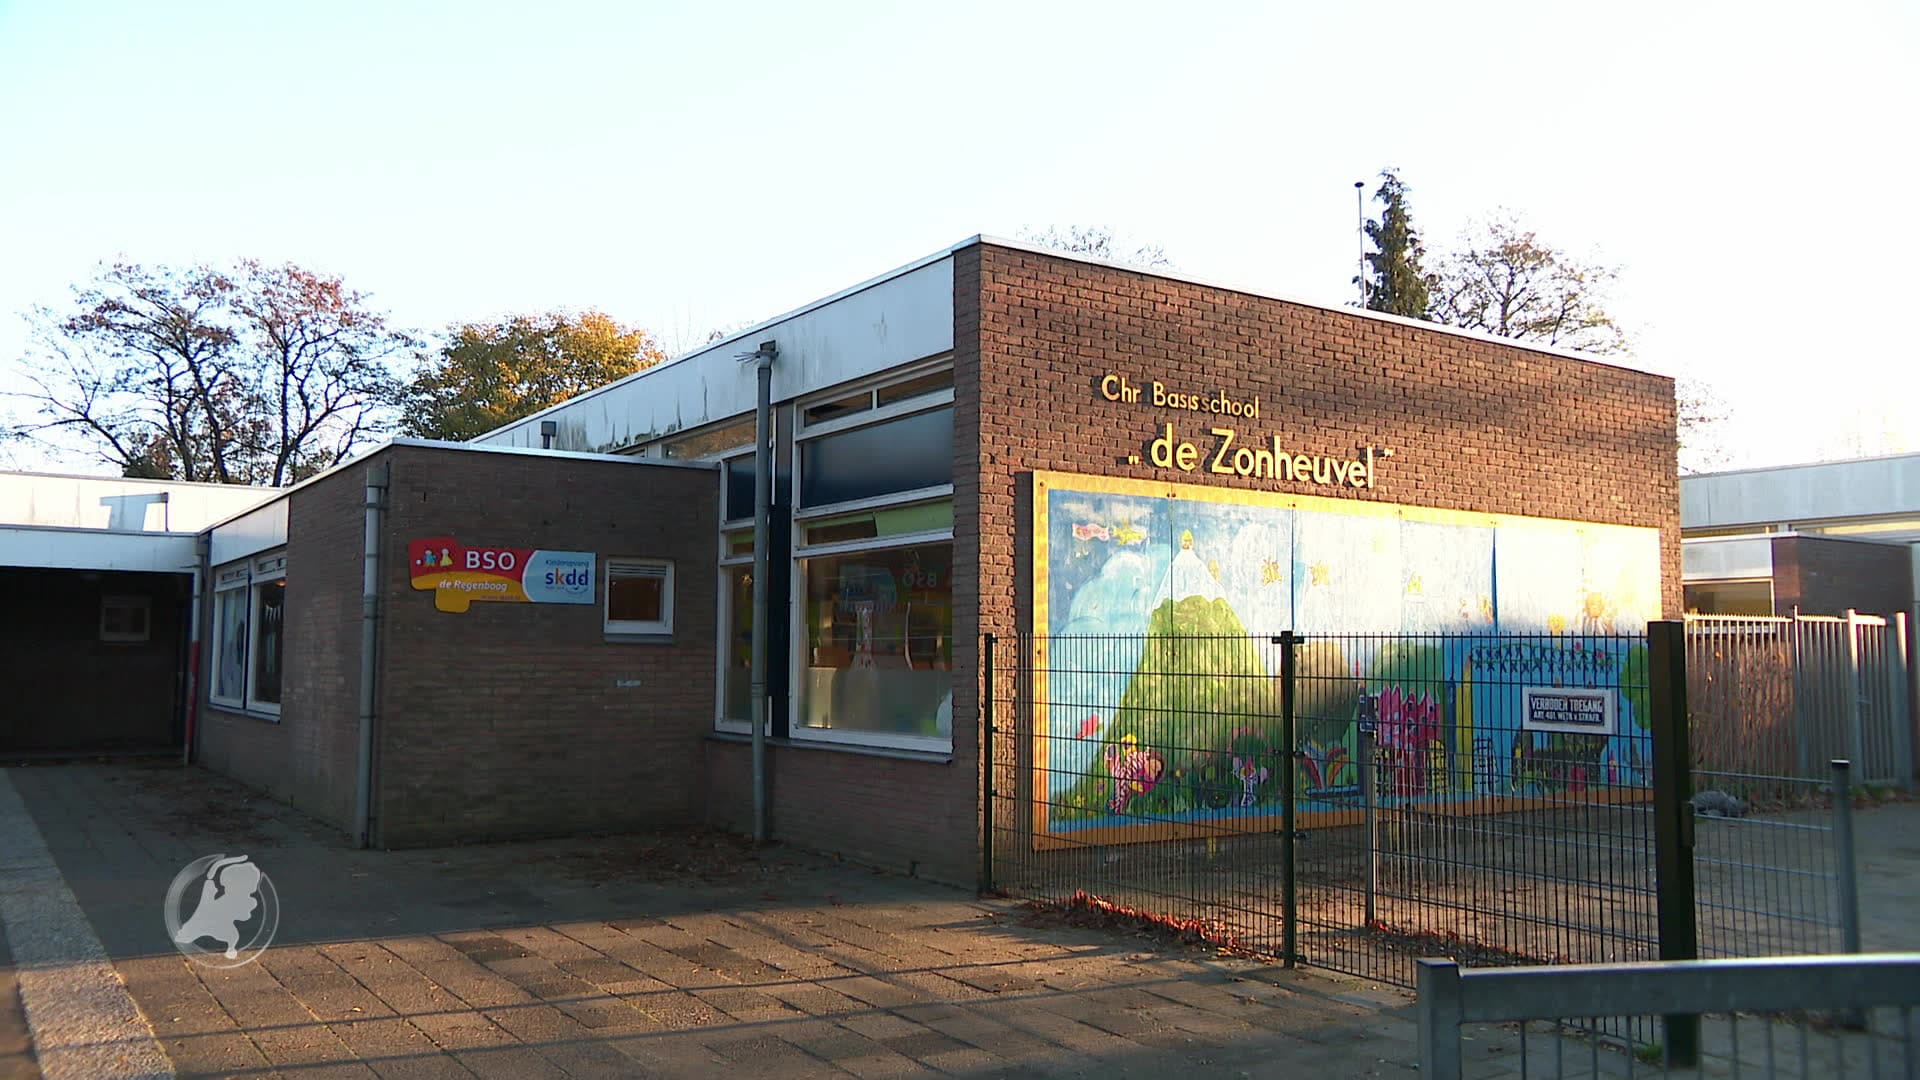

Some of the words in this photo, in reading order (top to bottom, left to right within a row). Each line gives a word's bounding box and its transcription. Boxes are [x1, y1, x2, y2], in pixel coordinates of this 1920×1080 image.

[1101, 375, 1141, 404] Chr
[1153, 382, 1260, 419] Basisschool
[465, 550, 516, 570] BSO
[439, 579, 452, 589] de
[454, 580, 508, 592] Regenboog
[545, 568, 589, 586] skdd
[1530, 697, 1568, 711] VERBODEN
[1569, 699, 1603, 713] TOEGANG
